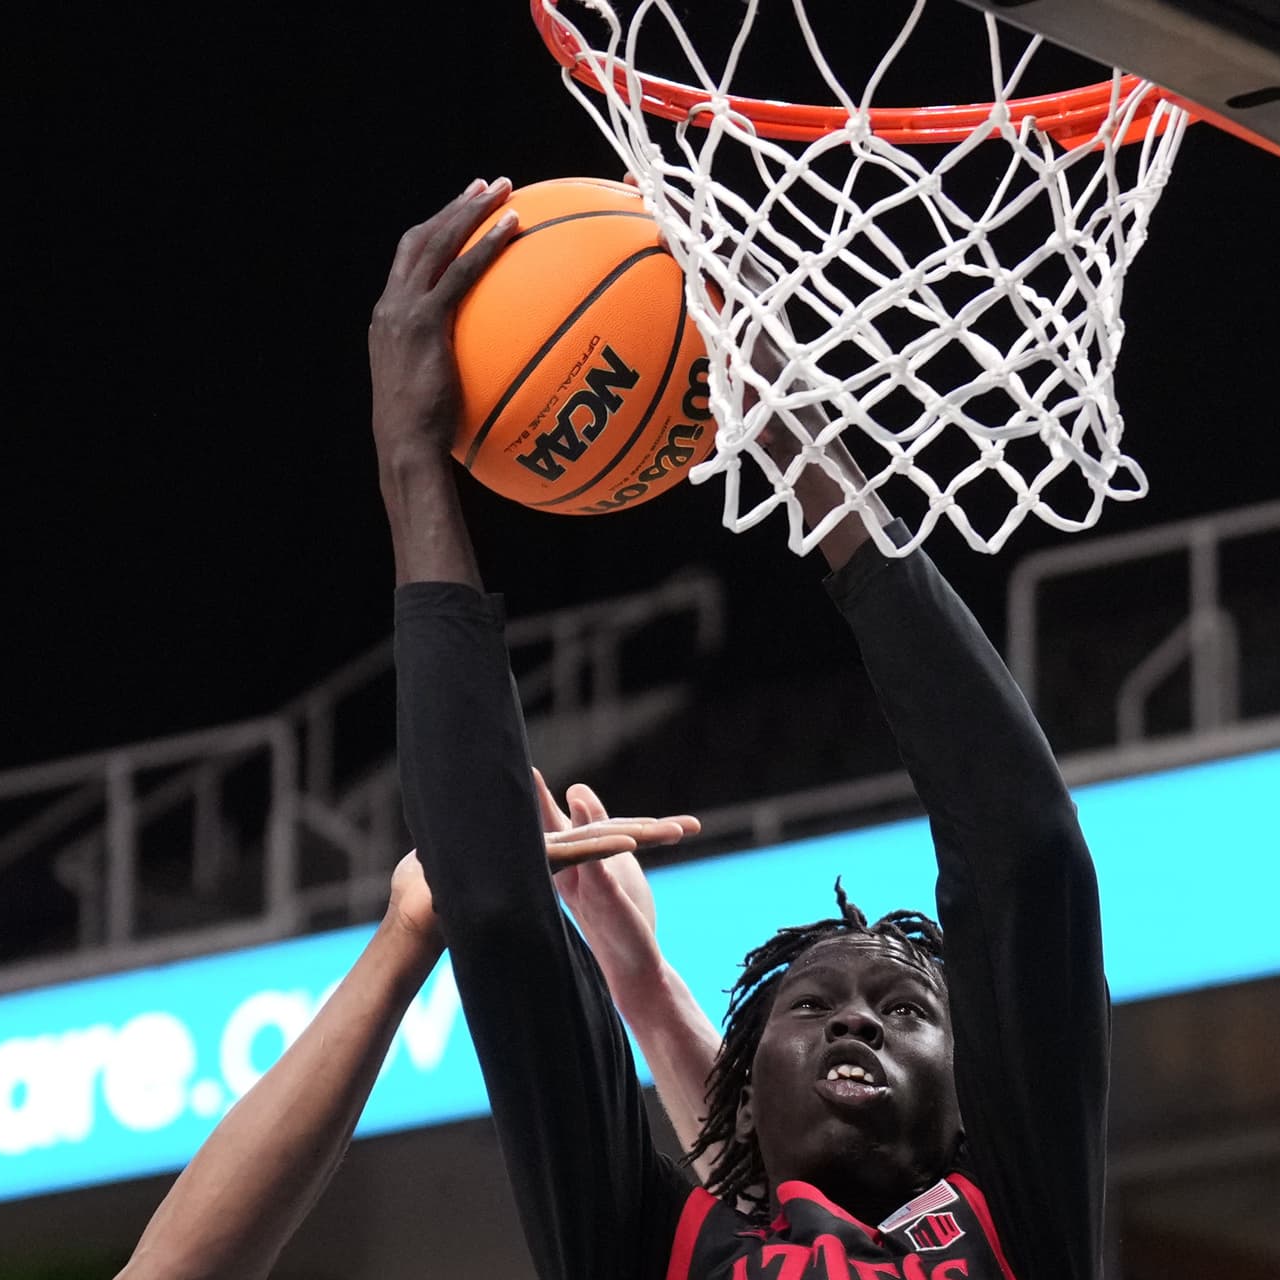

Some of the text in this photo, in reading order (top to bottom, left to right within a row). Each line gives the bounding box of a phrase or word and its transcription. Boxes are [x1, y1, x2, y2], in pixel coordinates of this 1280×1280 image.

[557, 335, 600, 393] OFFICIAL
[515, 344, 641, 482] NCAA
[528, 395, 560, 431] GAME
